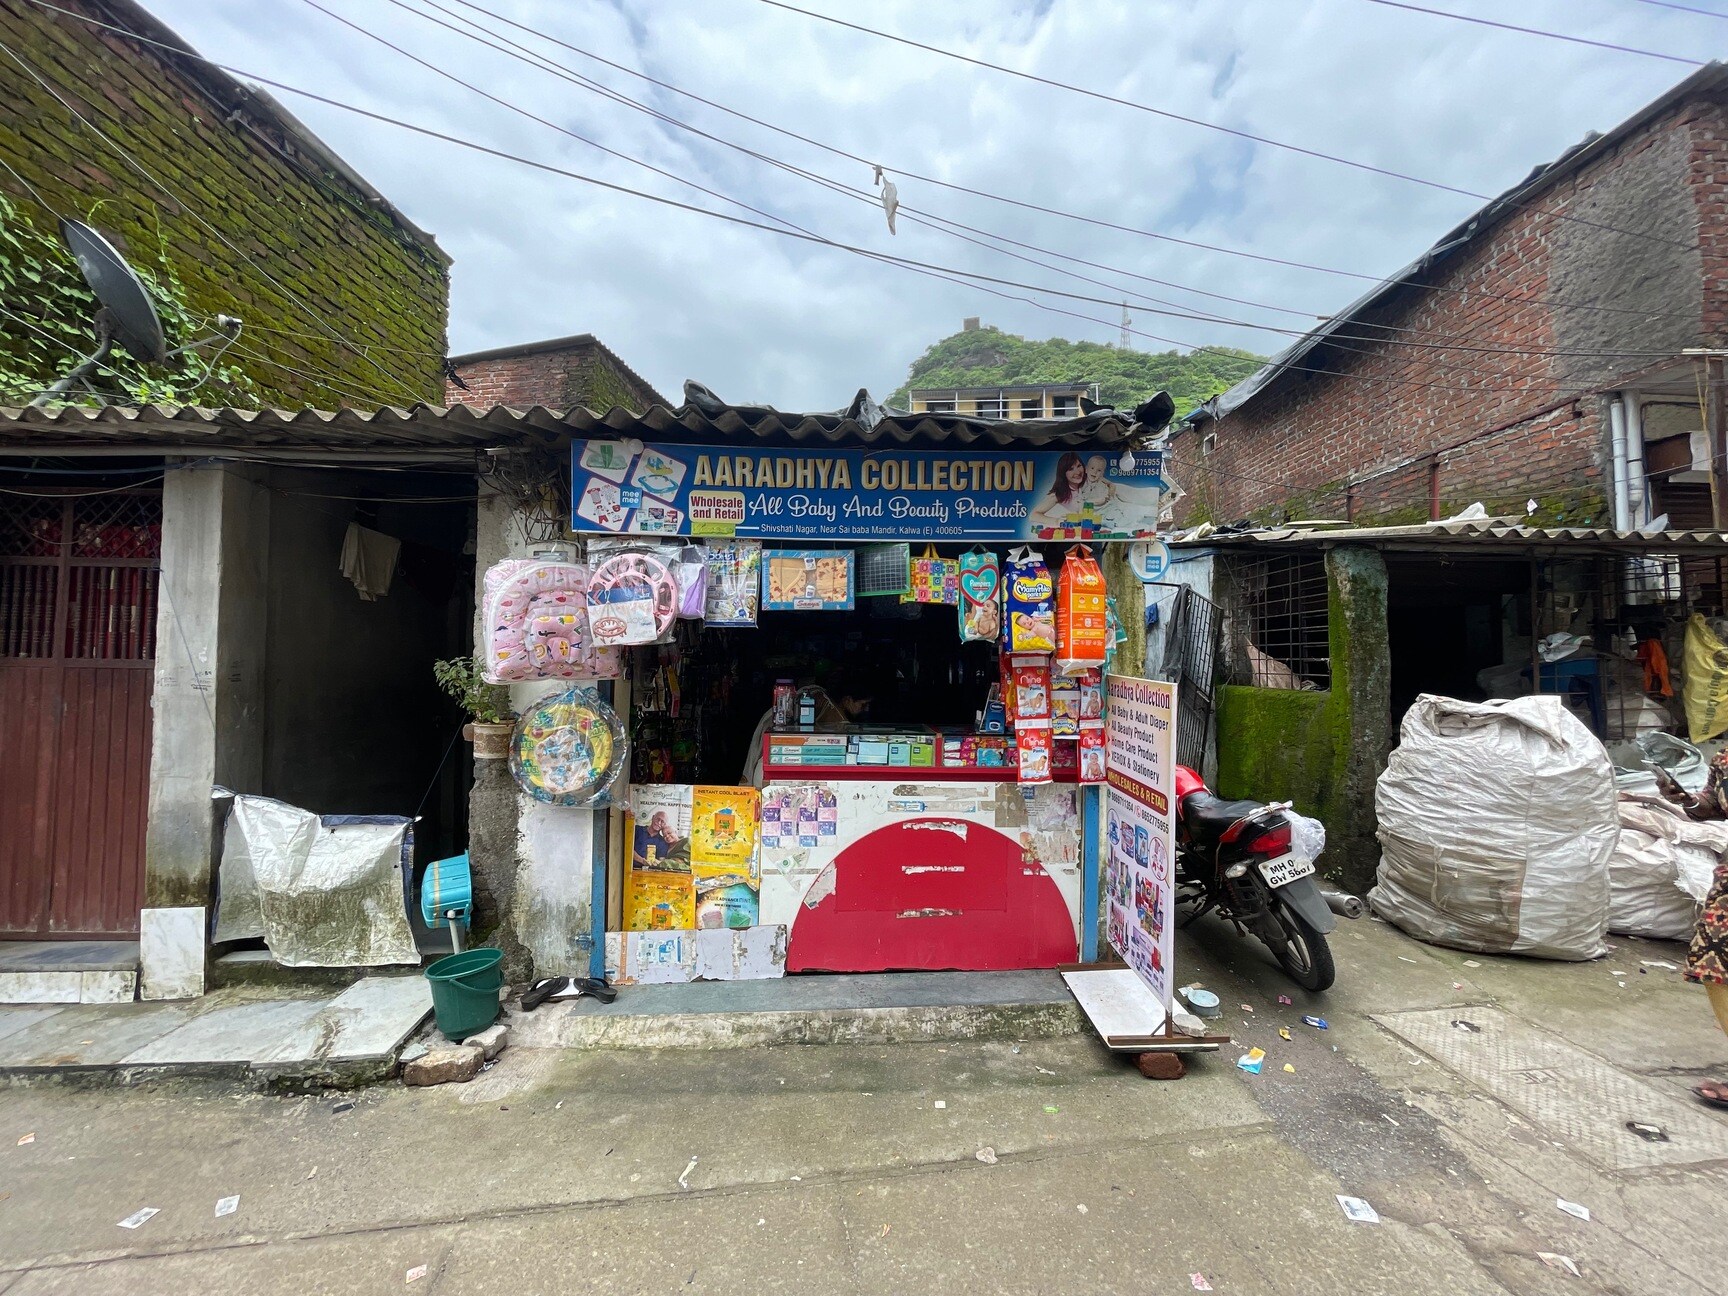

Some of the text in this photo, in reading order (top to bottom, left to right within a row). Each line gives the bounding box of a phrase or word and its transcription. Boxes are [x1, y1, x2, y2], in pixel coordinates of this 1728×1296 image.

[693, 455, 1034, 491] AARADHYA COLLECTION
[690, 496, 743, 508] Wholesale
[693, 508, 743, 519] and Retail
[748, 493, 1027, 523] All Baby And Beauty Products
[761, 523, 794, 533] Shivshati
[820, 525, 837, 534] Near
[852, 525, 870, 534] baba
[899, 526, 921, 535] Kalwa
[922, 526, 933, 537] (E)
[935, 526, 963, 535] 400605
[1107, 679, 1134, 704] Aaradhya
[1135, 683, 1170, 709] Collection
[1117, 706, 1128, 721] Baby
[1135, 710, 1148, 725] Adult
[1150, 714, 1169, 731] Diaper
[1117, 721, 1133, 739] Beauty
[1134, 726, 1154, 745] Product
[1138, 744, 1158, 764] Product
[1132, 759, 1160, 785] Stationery
[1145, 789, 1167, 812] RETAIL
[1269, 862, 1287, 874] MH
[1269, 874, 1287, 885] GW
